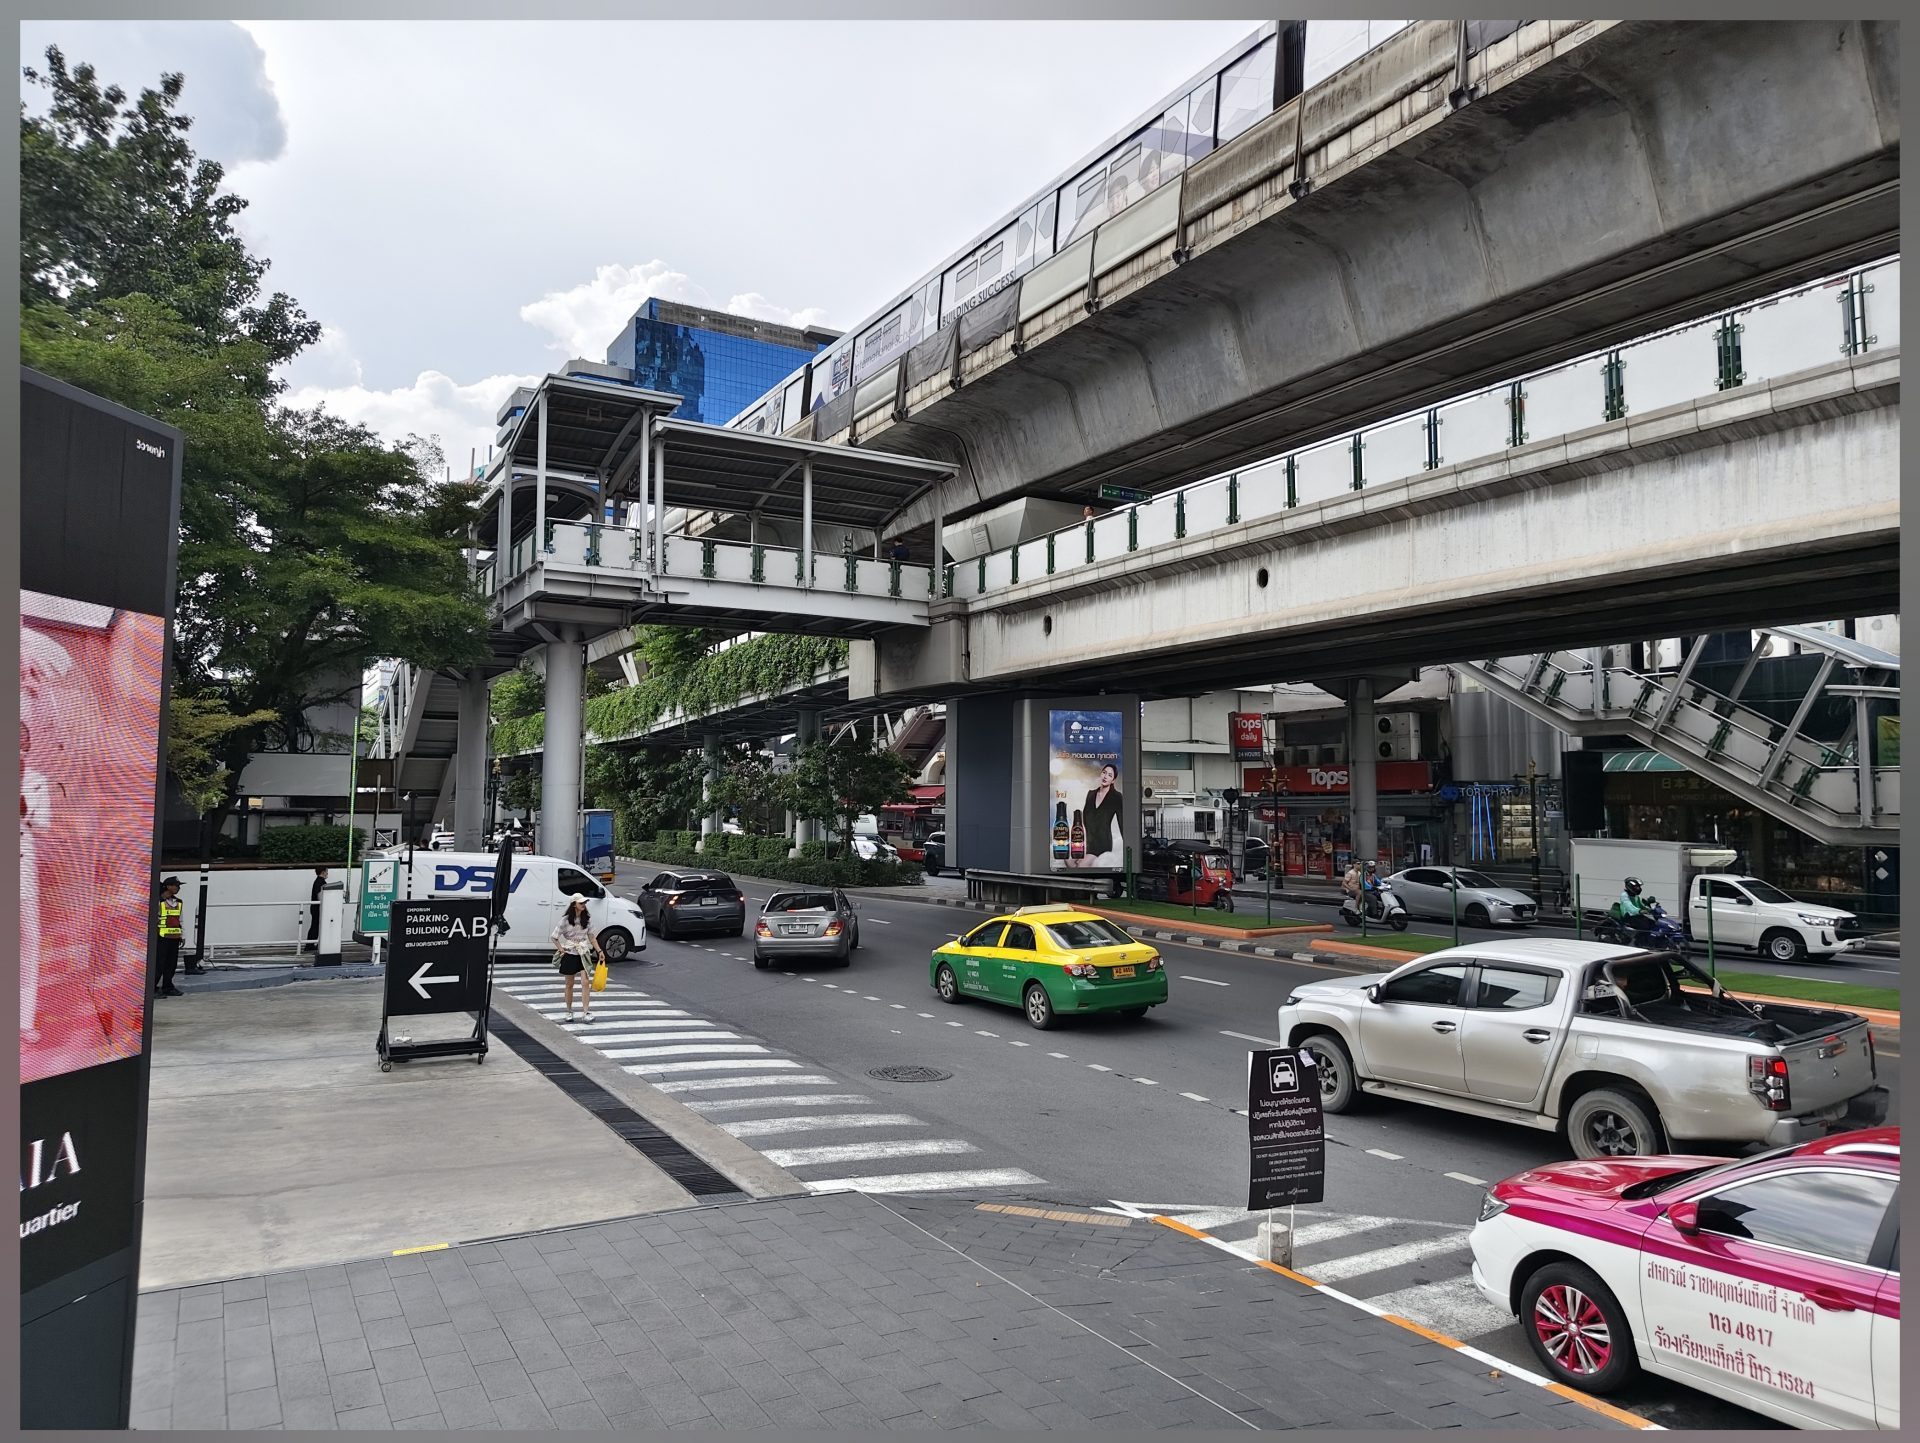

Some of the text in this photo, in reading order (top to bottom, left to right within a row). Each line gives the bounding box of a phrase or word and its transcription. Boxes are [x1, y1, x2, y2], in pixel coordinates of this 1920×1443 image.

[942, 269, 1015, 328] BUILDING SUCCESS
[1235, 717, 1261, 731] Tops
[1240, 732, 1257, 743] daily
[1307, 768, 1348, 789] Tops
[405, 926, 449, 935] BUILDING
[406, 914, 449, 923] PARKING
[448, 916, 488, 940] A,B
[20, 1131, 81, 1192] IA
[1647, 1261, 1816, 1325] สหกรณ์ ราชพฤกษ์แท็กซี่ จำกัด
[1708, 1312, 1773, 1348] ทอ 4817
[1654, 1325, 1745, 1375] ร้องเรียนแท็กซี่
